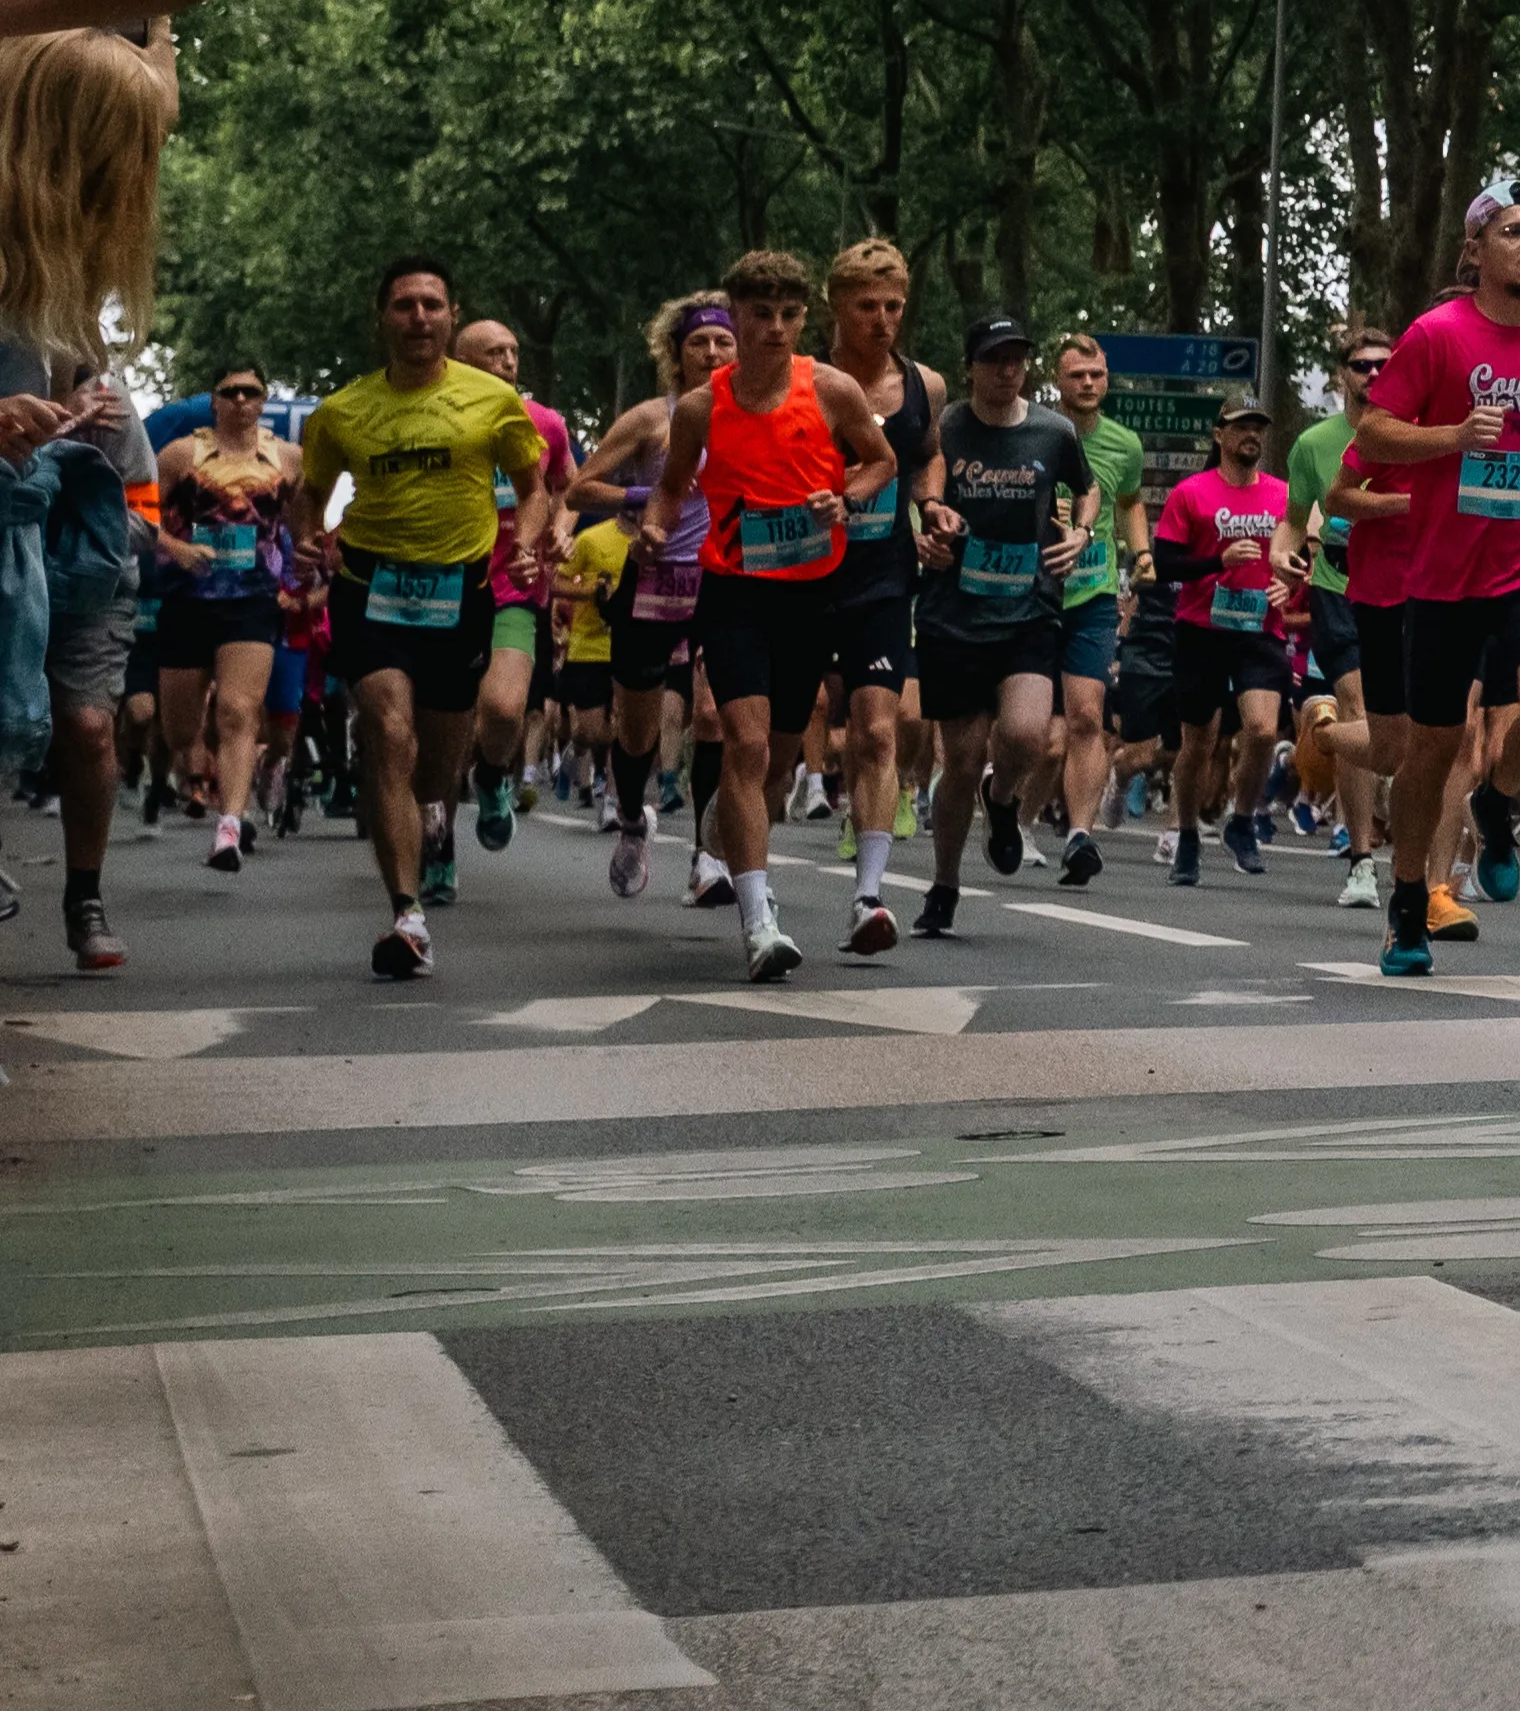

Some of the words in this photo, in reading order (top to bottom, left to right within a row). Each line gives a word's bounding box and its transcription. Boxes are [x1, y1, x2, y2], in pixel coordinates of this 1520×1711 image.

[1116, 397, 1176, 414] TOUTES
[1113, 414, 1213, 431] DIRECTIONS
[966, 460, 1036, 486] Courir
[767, 518, 808, 543] 1183
[979, 550, 1024, 575] 2427
